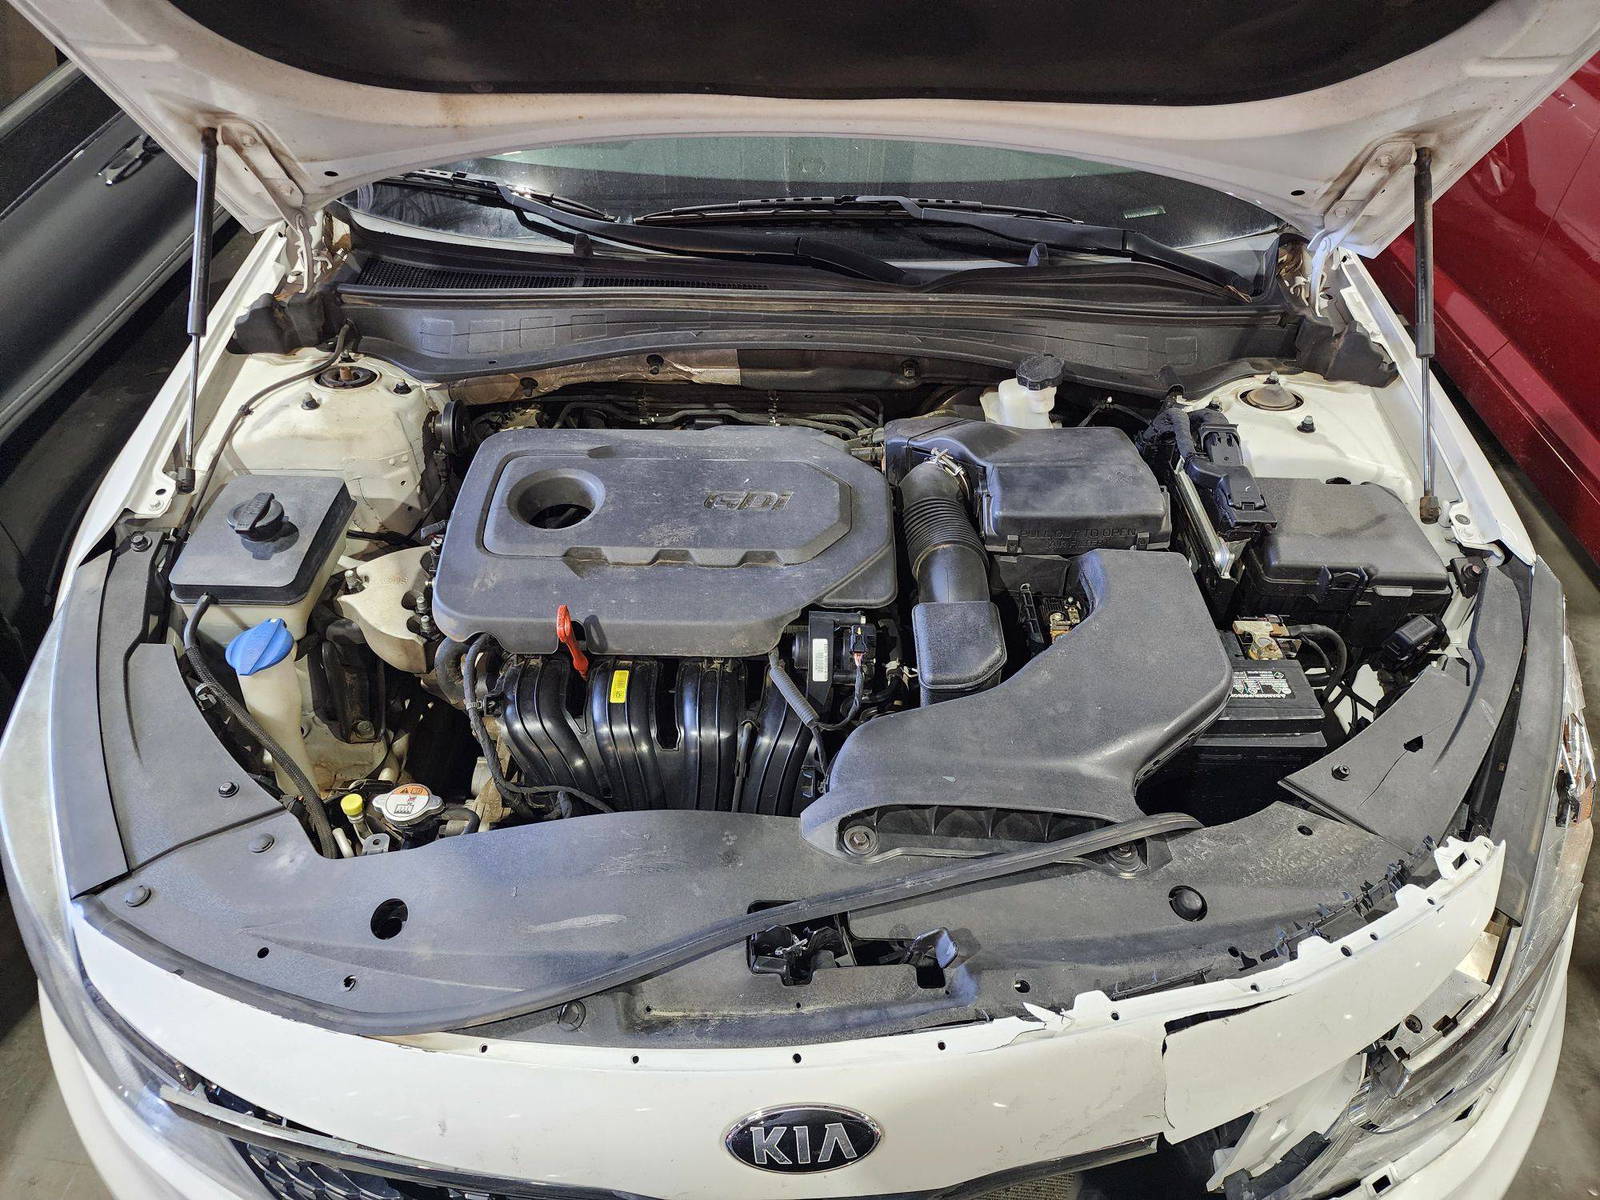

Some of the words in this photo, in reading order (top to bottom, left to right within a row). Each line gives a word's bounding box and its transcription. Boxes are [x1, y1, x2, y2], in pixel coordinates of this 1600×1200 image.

[1084, 528, 1099, 538] TO
[1102, 527, 1137, 538] OPEN
[750, 1122, 858, 1165] KIA
